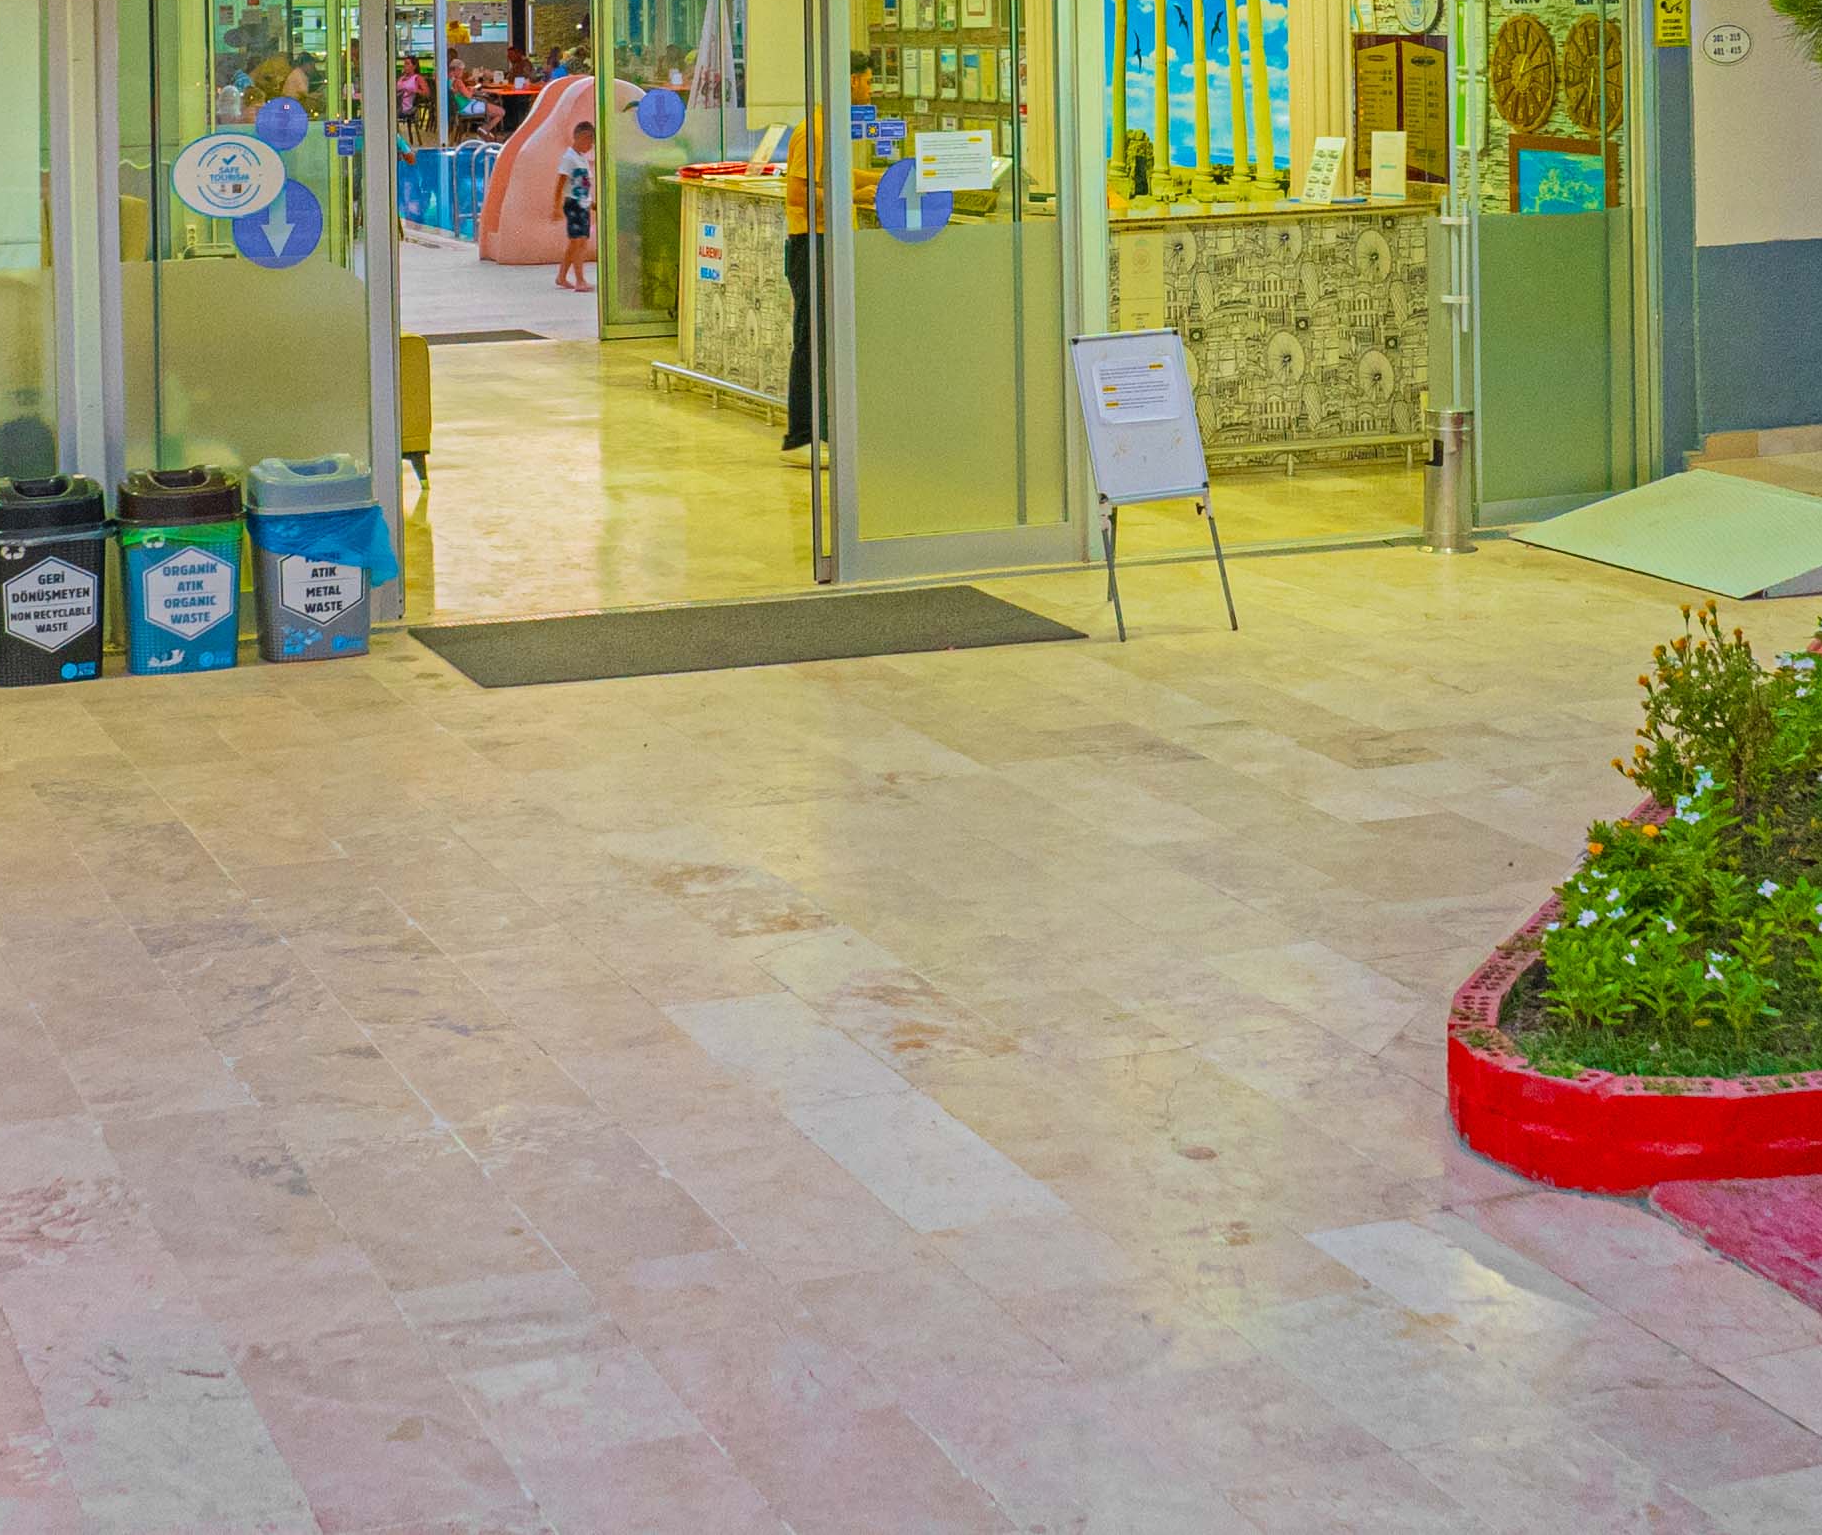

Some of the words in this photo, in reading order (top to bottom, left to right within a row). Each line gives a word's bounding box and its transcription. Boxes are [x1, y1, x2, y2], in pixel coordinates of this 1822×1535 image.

[311, 567, 337, 578] ATIK
[177, 580, 204, 592] ATIK
[306, 585, 341, 598] METAL
[164, 595, 217, 609] ORGANIC
[305, 601, 343, 613] WASTE
[10, 612, 32, 622] NON
[33, 606, 92, 620] RECYCLABLE
[170, 612, 211, 624] WASTE
[35, 622, 68, 633] WASTE
